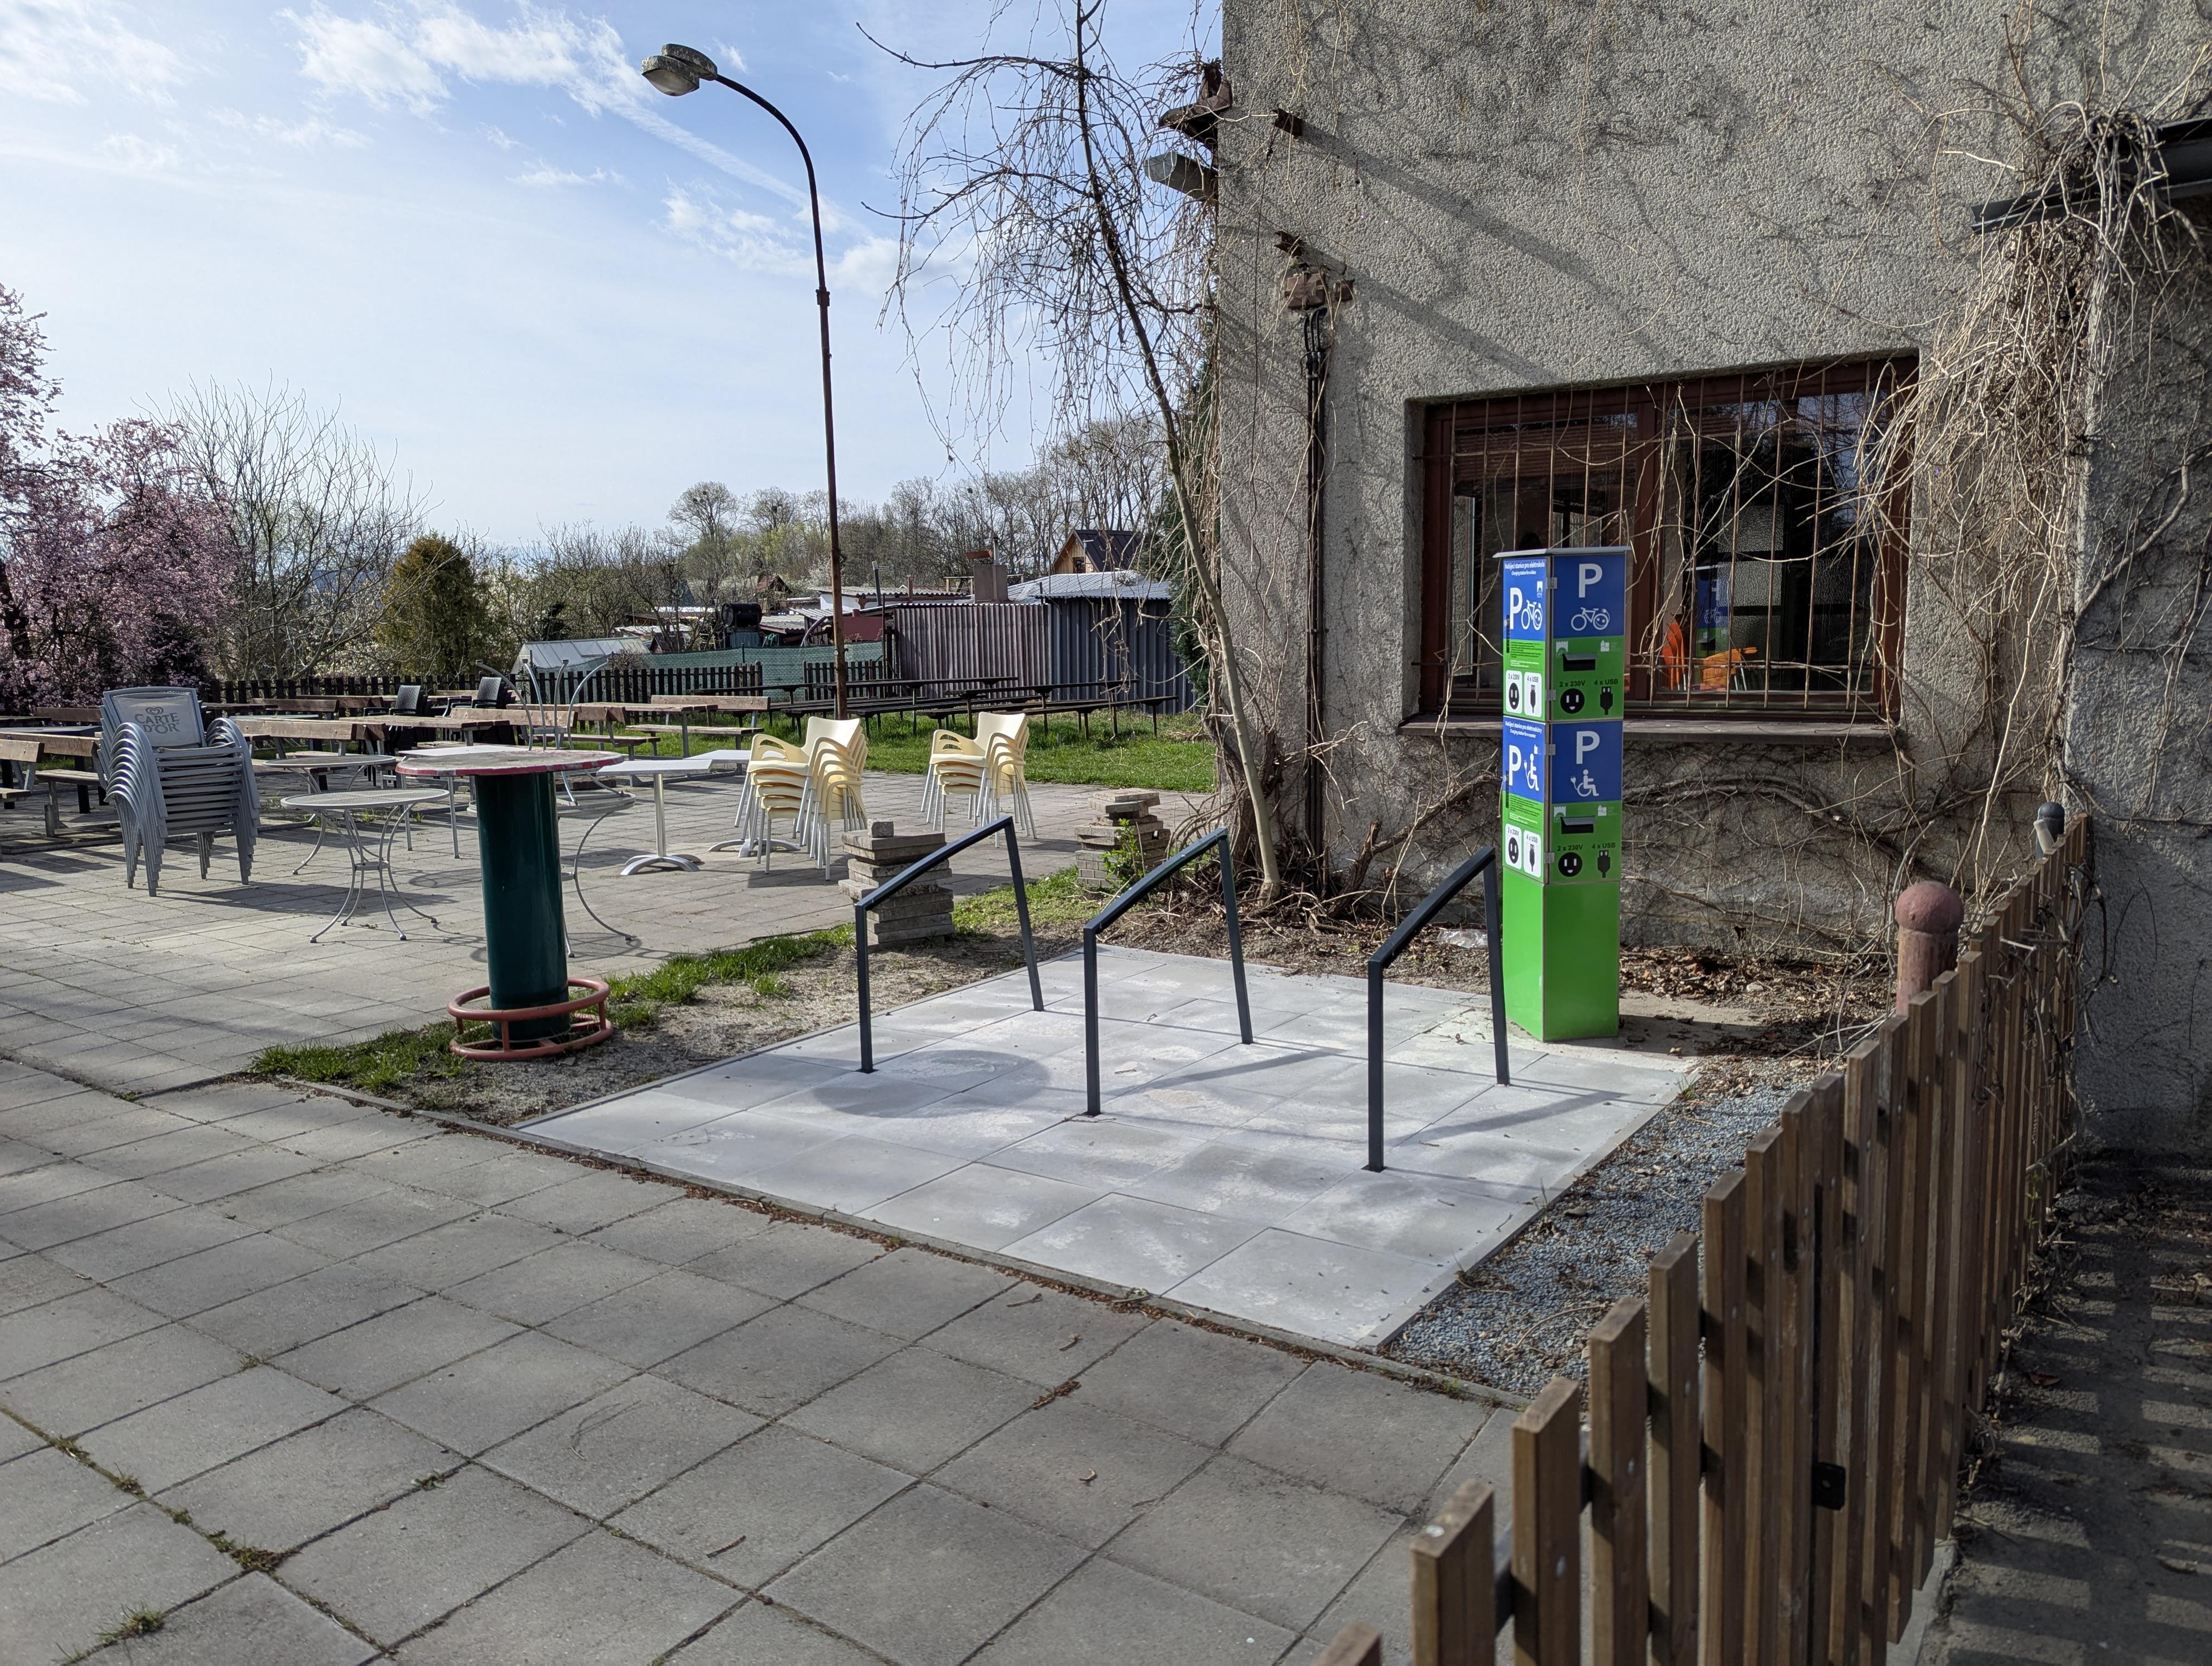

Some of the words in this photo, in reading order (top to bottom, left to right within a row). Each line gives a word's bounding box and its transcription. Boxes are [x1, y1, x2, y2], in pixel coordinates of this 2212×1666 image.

[1579, 564, 1602, 598] P
[1510, 588, 1522, 629] P
[134, 712, 179, 725] CARTE
[1576, 731, 1600, 764] P
[1509, 745, 1521, 786] P
